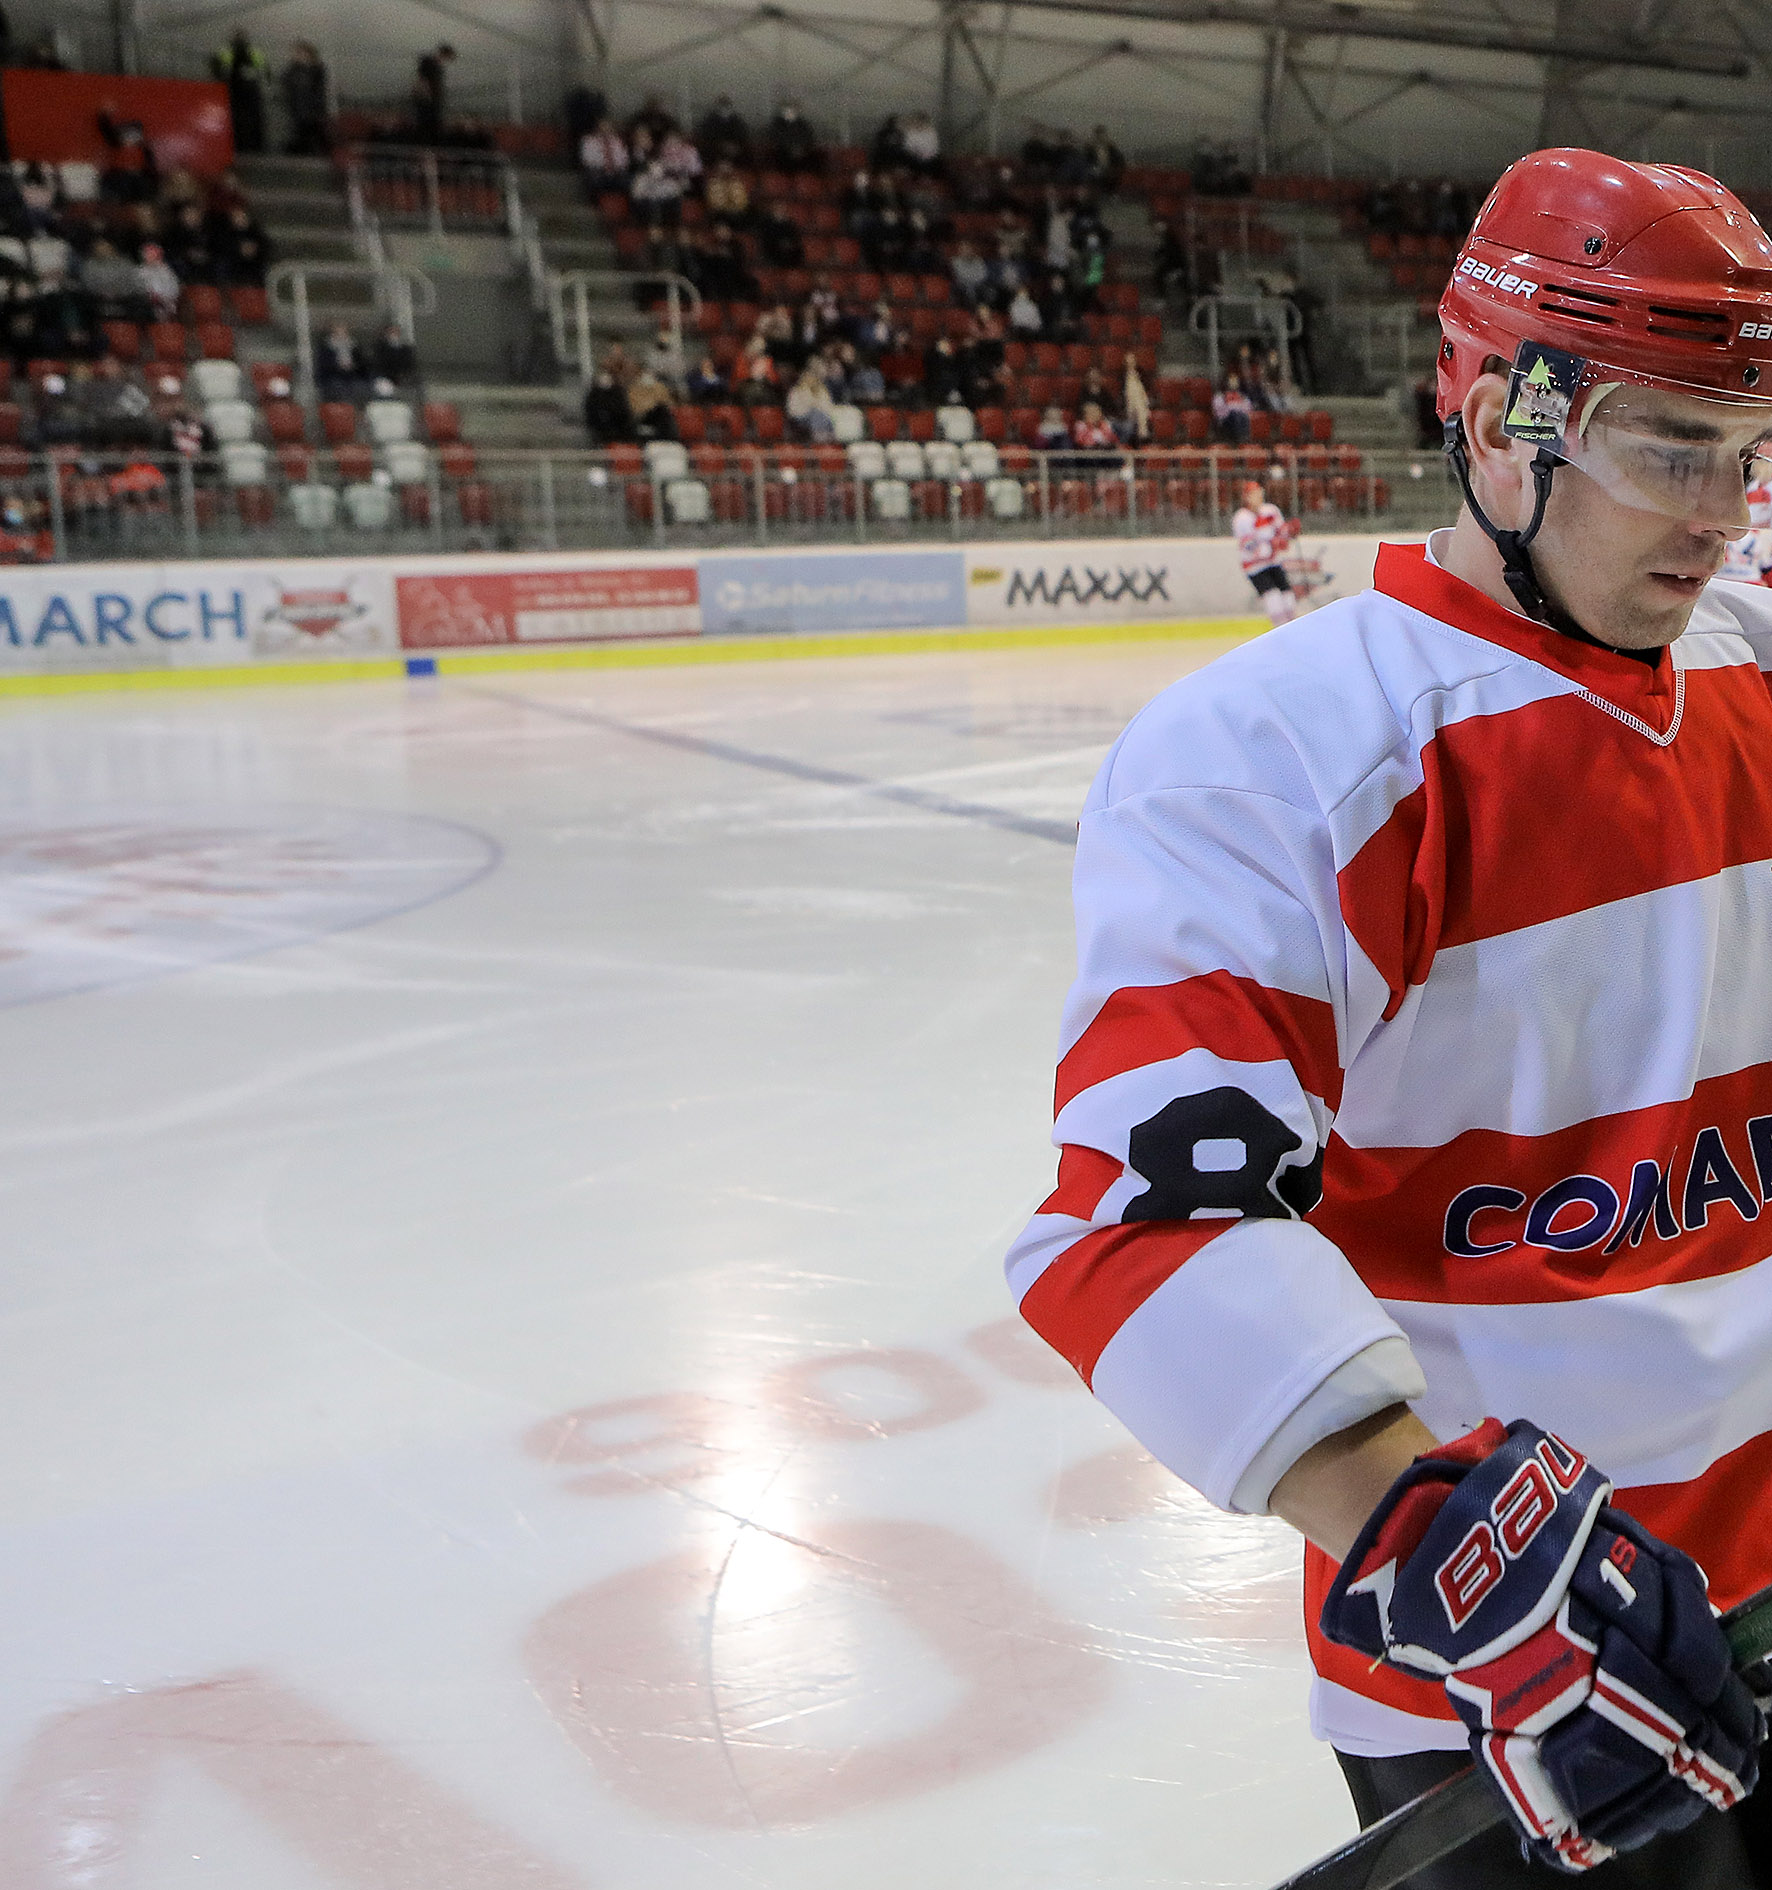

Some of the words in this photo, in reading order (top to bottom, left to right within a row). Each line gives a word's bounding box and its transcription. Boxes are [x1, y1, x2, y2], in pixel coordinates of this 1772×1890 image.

[1459, 256, 1540, 300] BAUER
[1514, 431, 1557, 441] FISCHER
[1121, 1086, 1326, 1224] 8
